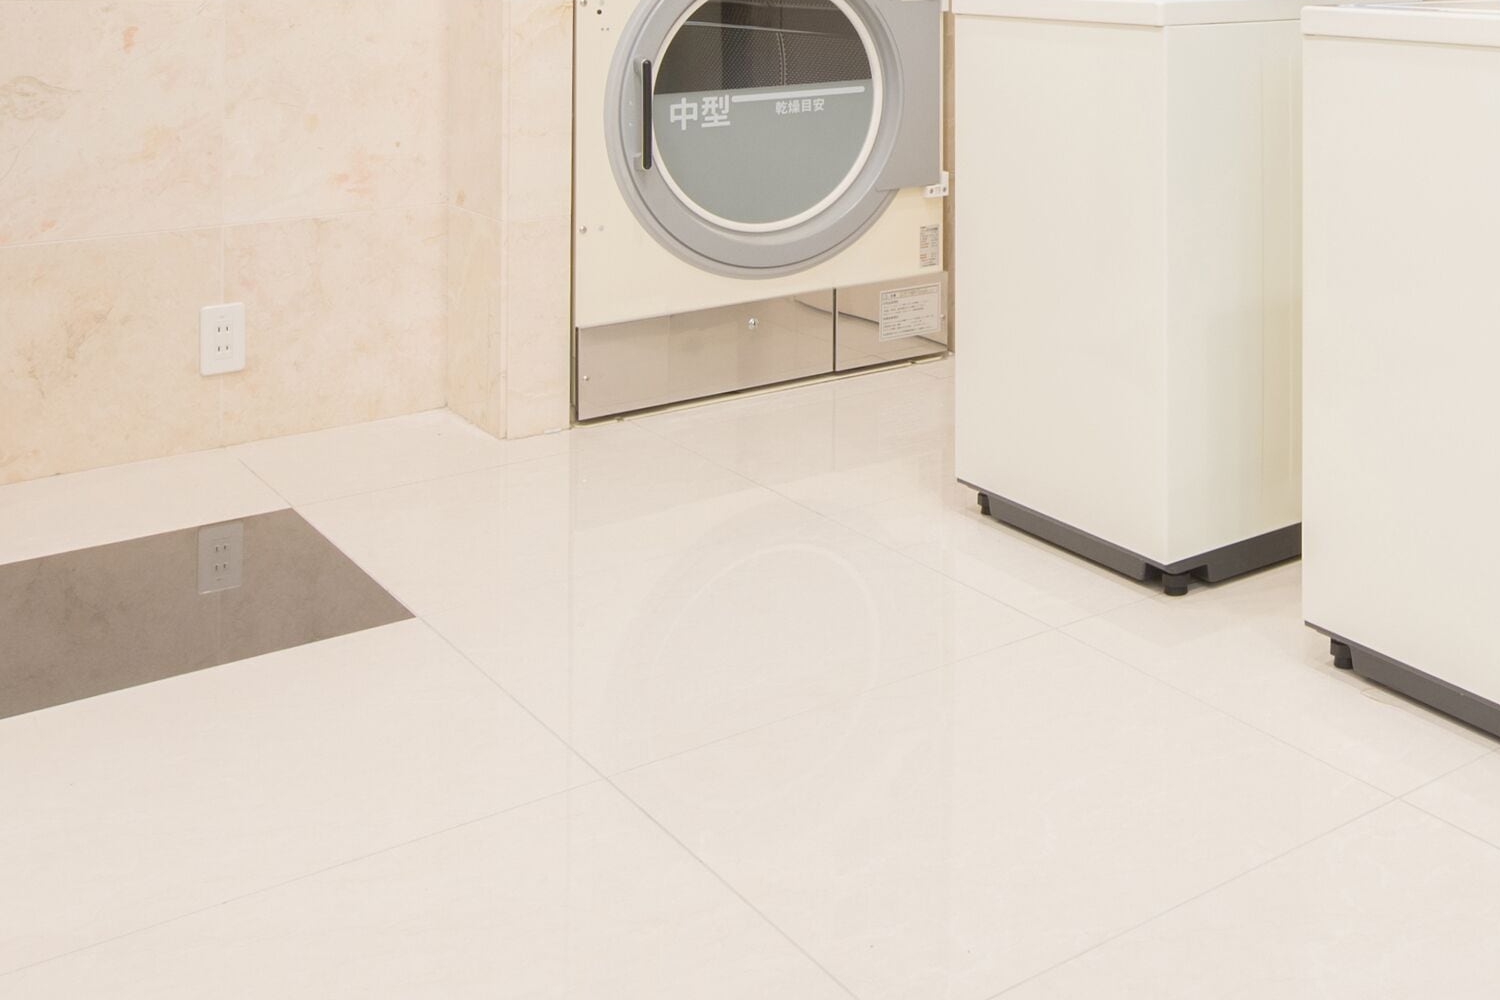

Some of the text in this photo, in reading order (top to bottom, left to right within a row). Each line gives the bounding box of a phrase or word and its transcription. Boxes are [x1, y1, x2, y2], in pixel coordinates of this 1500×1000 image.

[669, 94, 731, 131] 中型
[775, 99, 825, 115] 乾燥目安
